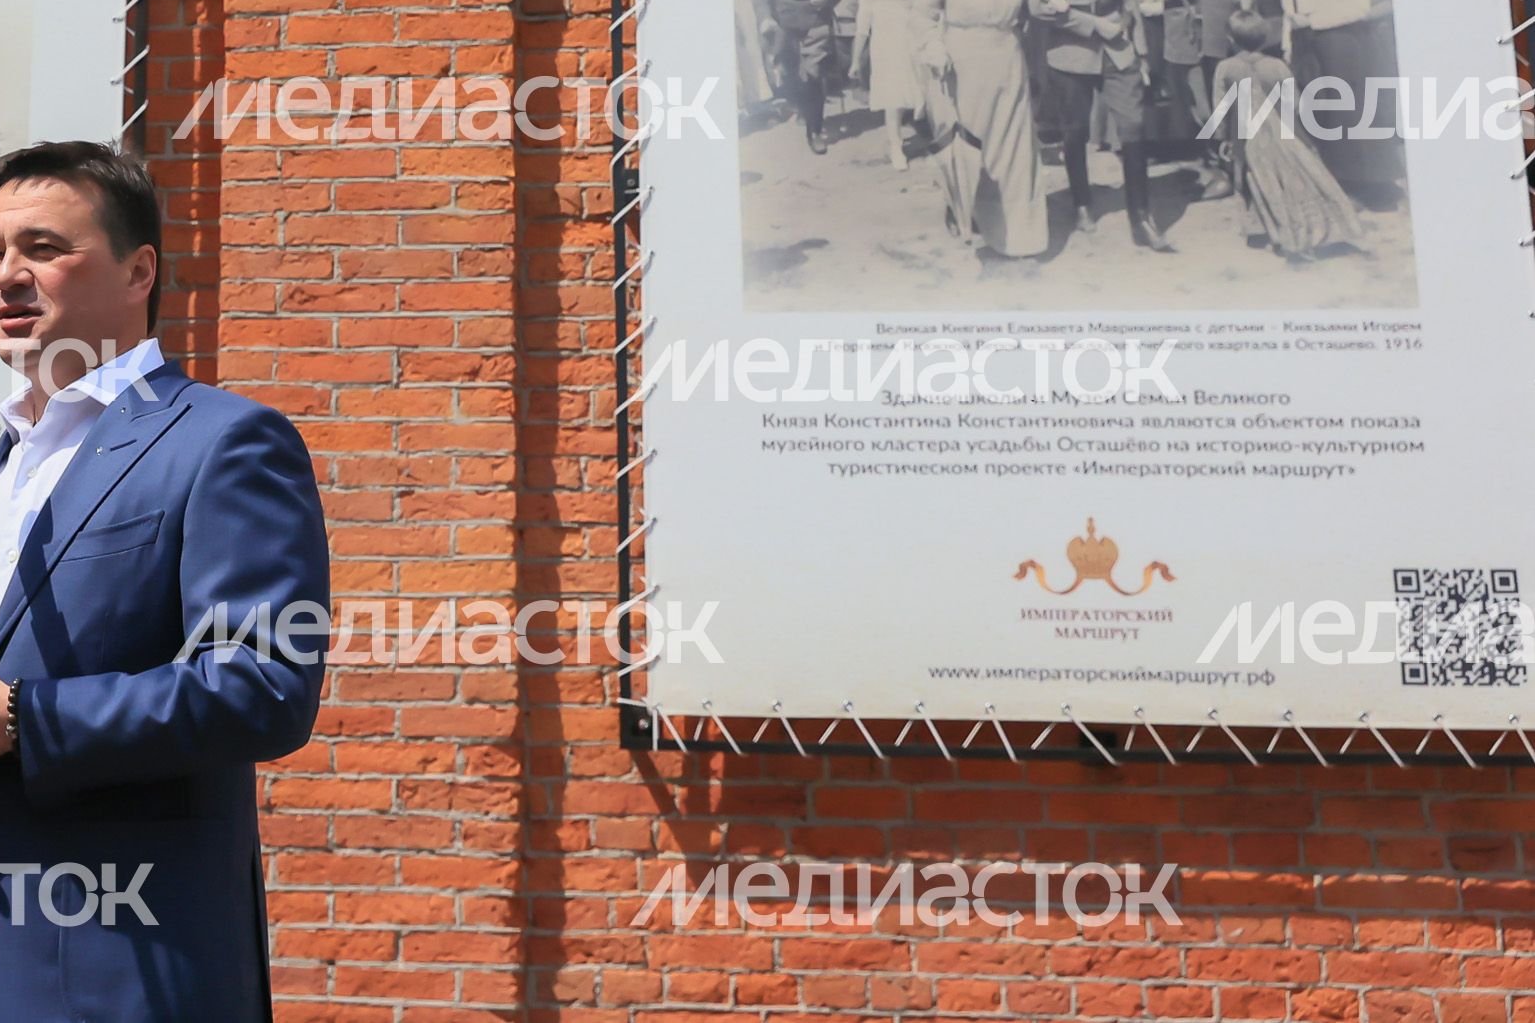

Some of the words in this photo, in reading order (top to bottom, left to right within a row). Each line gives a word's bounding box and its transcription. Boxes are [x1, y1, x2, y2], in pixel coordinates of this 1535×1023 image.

[1385, 337, 1423, 350] 1916
[1194, 389, 1291, 406] Великого
[762, 413, 818, 429] Князя
[825, 413, 952, 429] Константина
[958, 413, 1134, 429] Константиновича
[1141, 417, 1236, 429] являются
[1242, 413, 1344, 429] объектом
[1350, 418, 1421, 429] показа
[762, 435, 864, 452] музейного
[871, 439, 961, 453] кластера
[967, 437, 1051, 453] усадьбы
[1167, 440, 1190, 452] на
[1197, 439, 1425, 455] историко-культурном
[828, 462, 978, 476] туристическом
[985, 462, 1066, 476] проекте
[1073, 459, 1246, 477] «Императорский
[1252, 462, 1356, 479] маршрут»
[1020, 606, 1174, 623] ИМПЕРАТОРСКИЙ
[1054, 626, 1140, 642] МАРШРУТ
[928, 665, 1276, 686] www.императорскиймаршрут.рф
